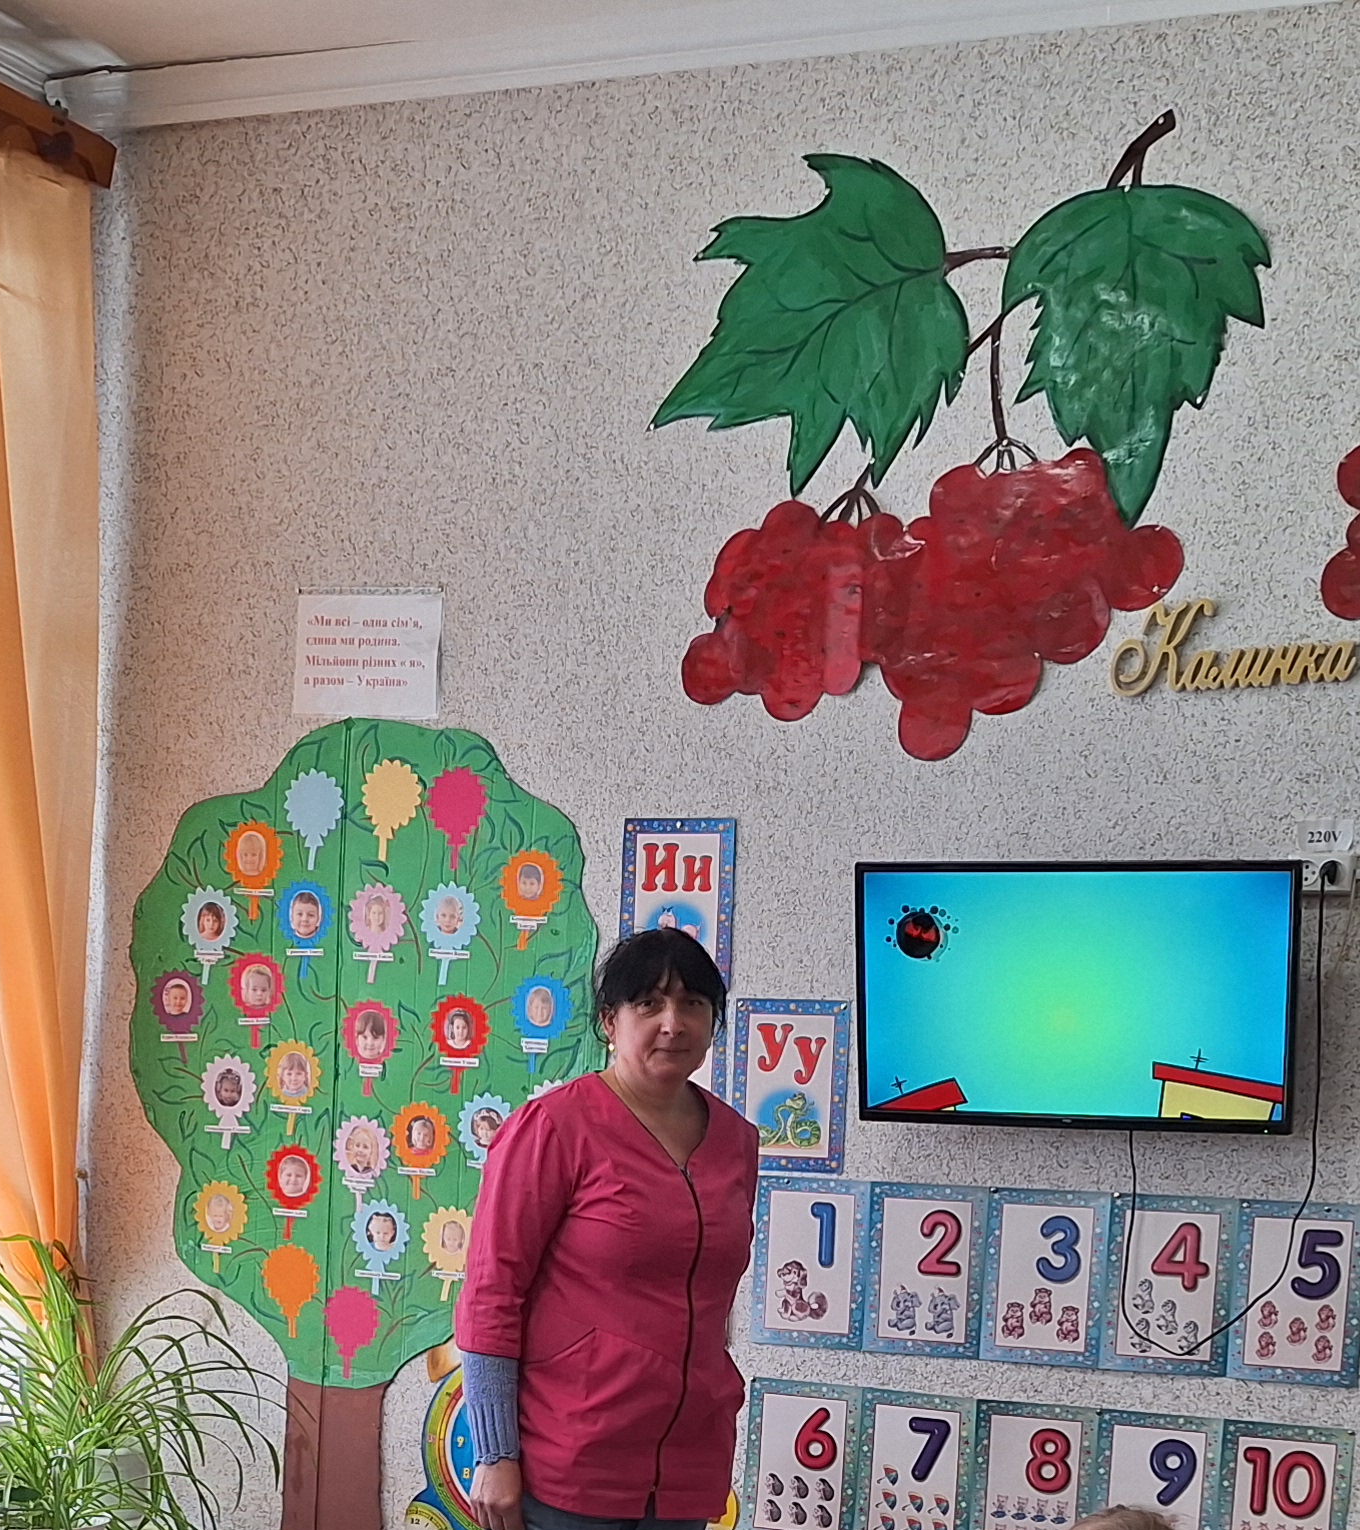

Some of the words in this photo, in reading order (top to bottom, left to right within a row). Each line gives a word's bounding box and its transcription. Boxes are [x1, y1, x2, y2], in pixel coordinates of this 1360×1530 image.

[307, 615, 331, 627] «Ми
[334, 616, 351, 627] всі
[362, 618, 388, 628] одна
[340, 637, 355, 646] ми
[1109, 598, 1360, 697] Калинка
[303, 676, 310, 685] а
[313, 676, 345, 688] разом
[356, 674, 408, 689] Україна»
[305, 655, 359, 667] Мільйони
[362, 656, 397, 670] різних
[1307, 830, 1342, 843] 220V
[810, 1202, 835, 1267] 1
[917, 1210, 962, 1277] 2
[1036, 1214, 1082, 1283] 3
[1151, 1221, 1210, 1291] 4
[1290, 1228, 1344, 1299] 5
[457, 1435, 465, 1448] 9
[794, 1407, 838, 1470] 6
[908, 1415, 951, 1482] 7
[1024, 1427, 1071, 1494] 8
[1149, 1438, 1197, 1506] 9
[1243, 1445, 1326, 1519] 10
[410, 1517, 420, 1525] 12
